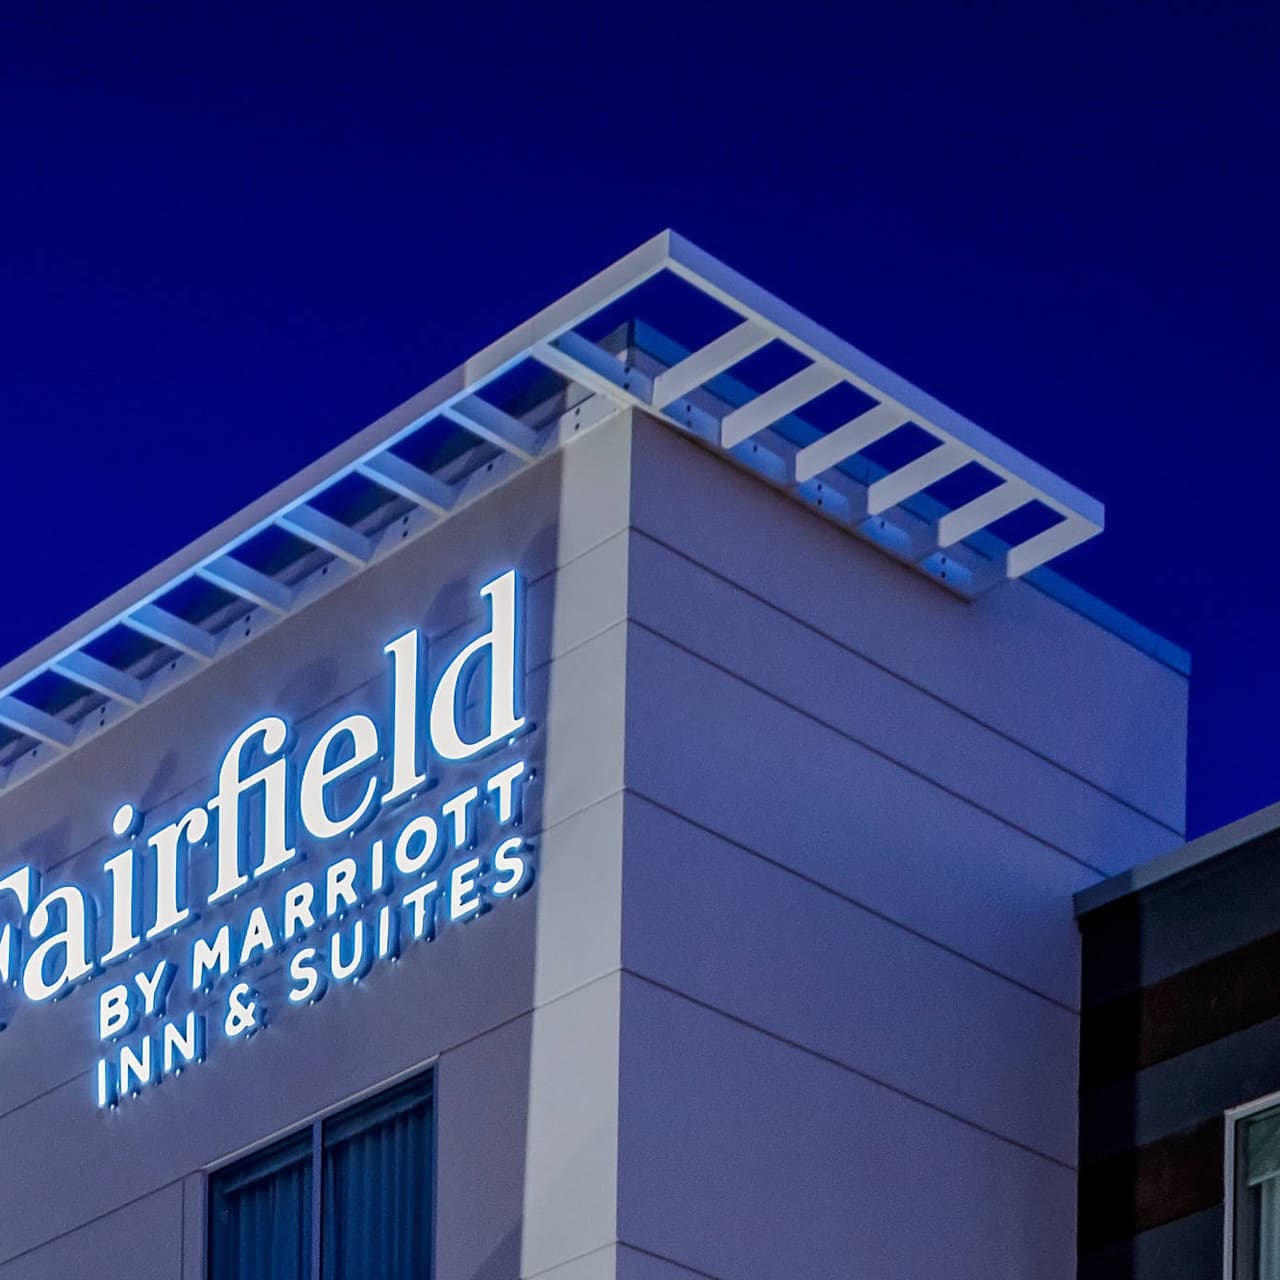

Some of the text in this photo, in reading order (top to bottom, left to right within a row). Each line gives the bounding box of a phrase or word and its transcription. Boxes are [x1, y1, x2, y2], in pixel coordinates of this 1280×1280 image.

[98, 838, 525, 1107] INN & SUITES
[100, 762, 525, 1040] BY MARRIOTT
